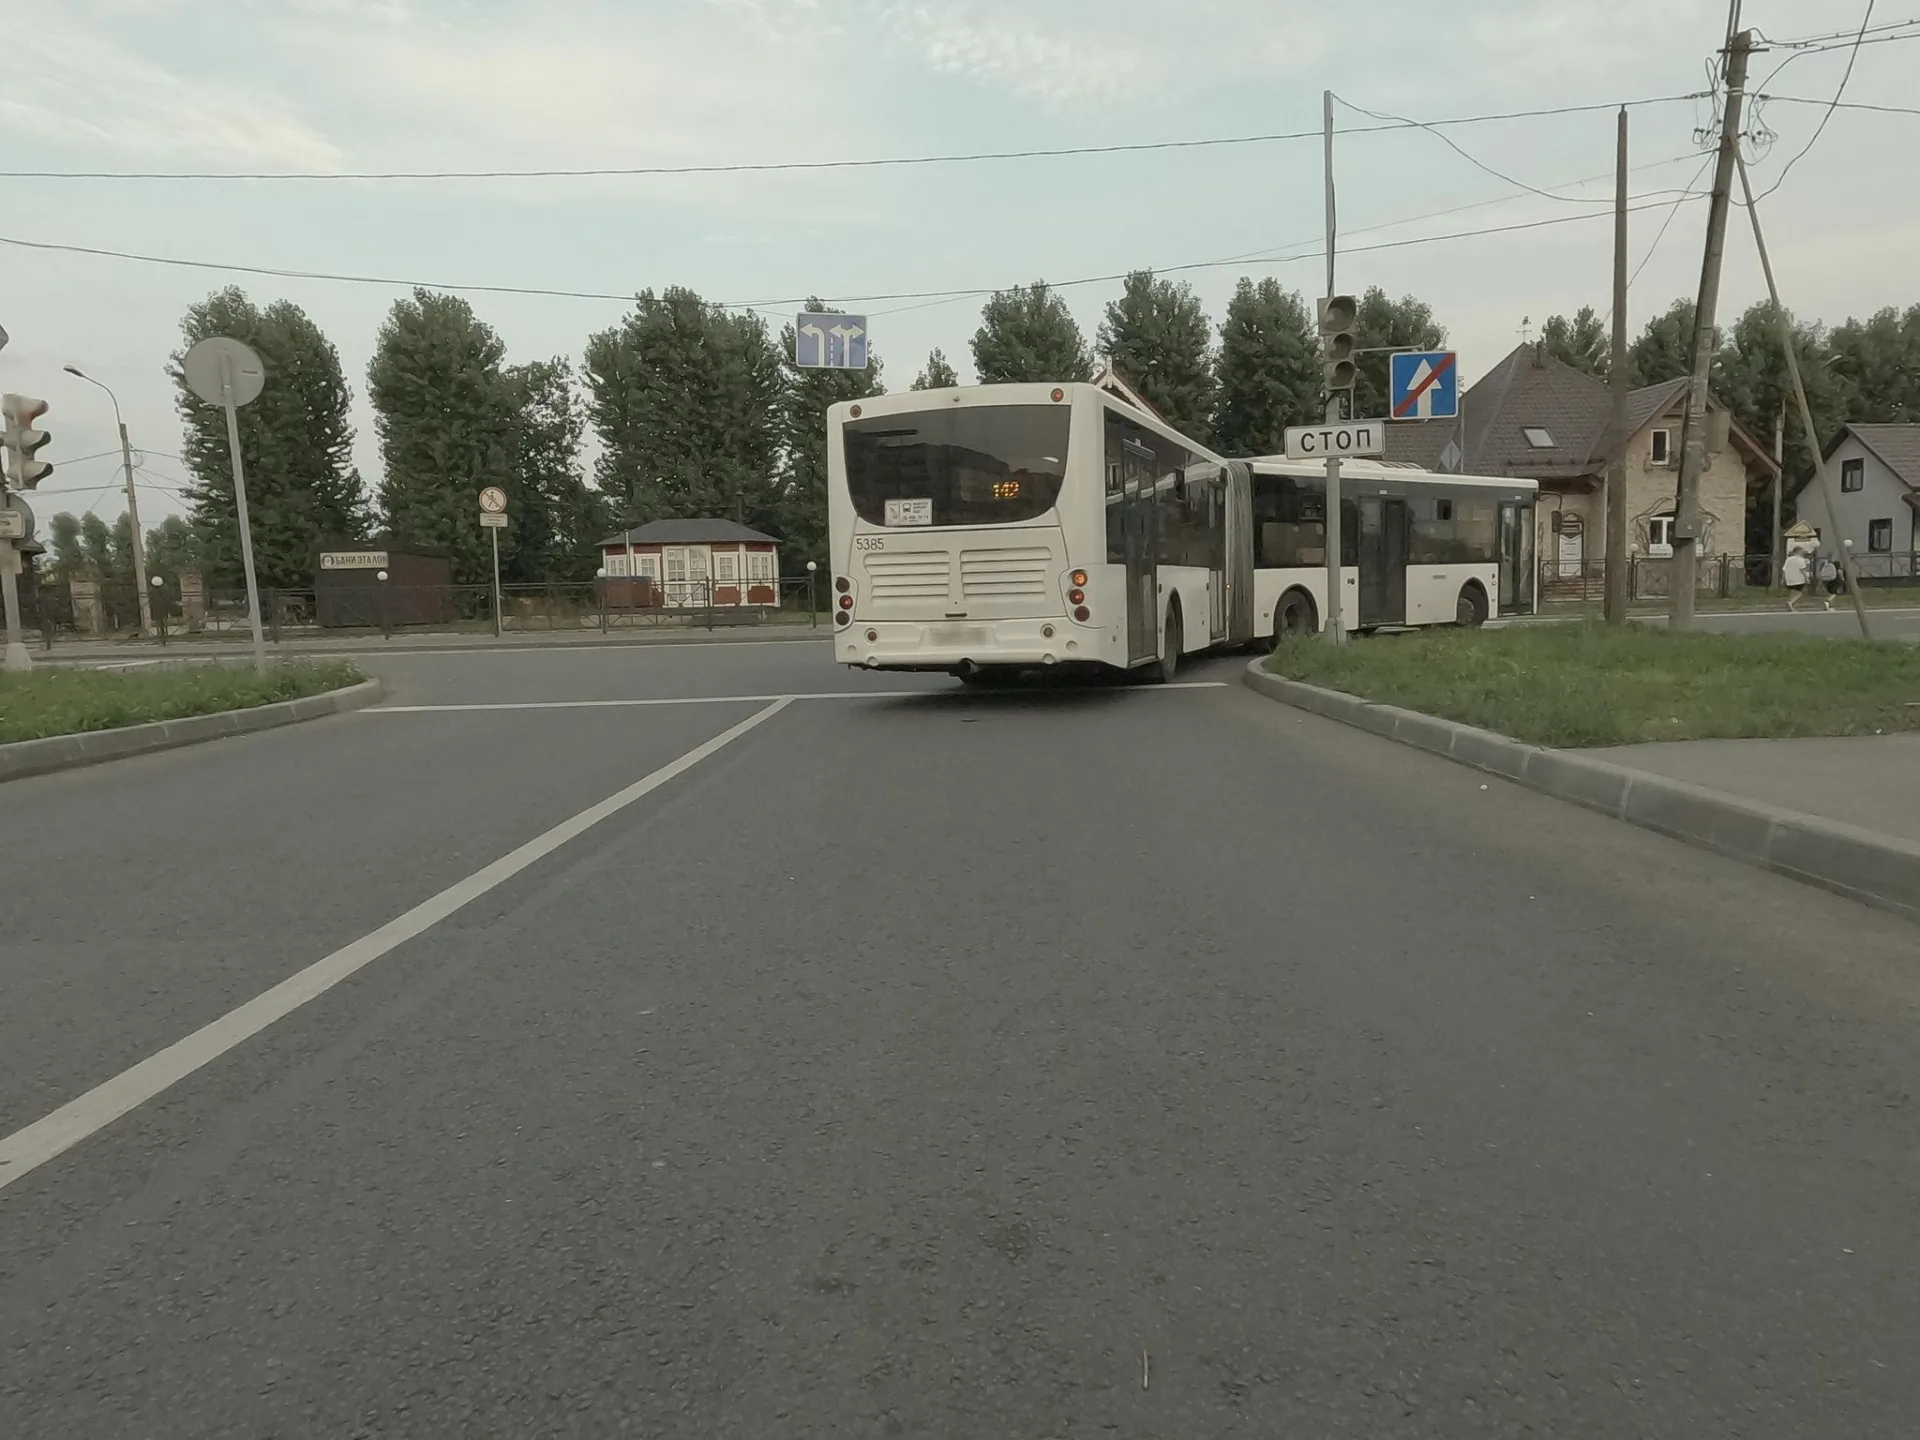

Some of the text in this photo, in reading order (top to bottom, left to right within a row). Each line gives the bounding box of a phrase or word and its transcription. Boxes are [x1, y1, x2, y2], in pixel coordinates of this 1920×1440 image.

[1301, 429, 1371, 452] СТОП
[856, 538, 885, 550] 5385
[335, 556, 356, 565] БАНИ
